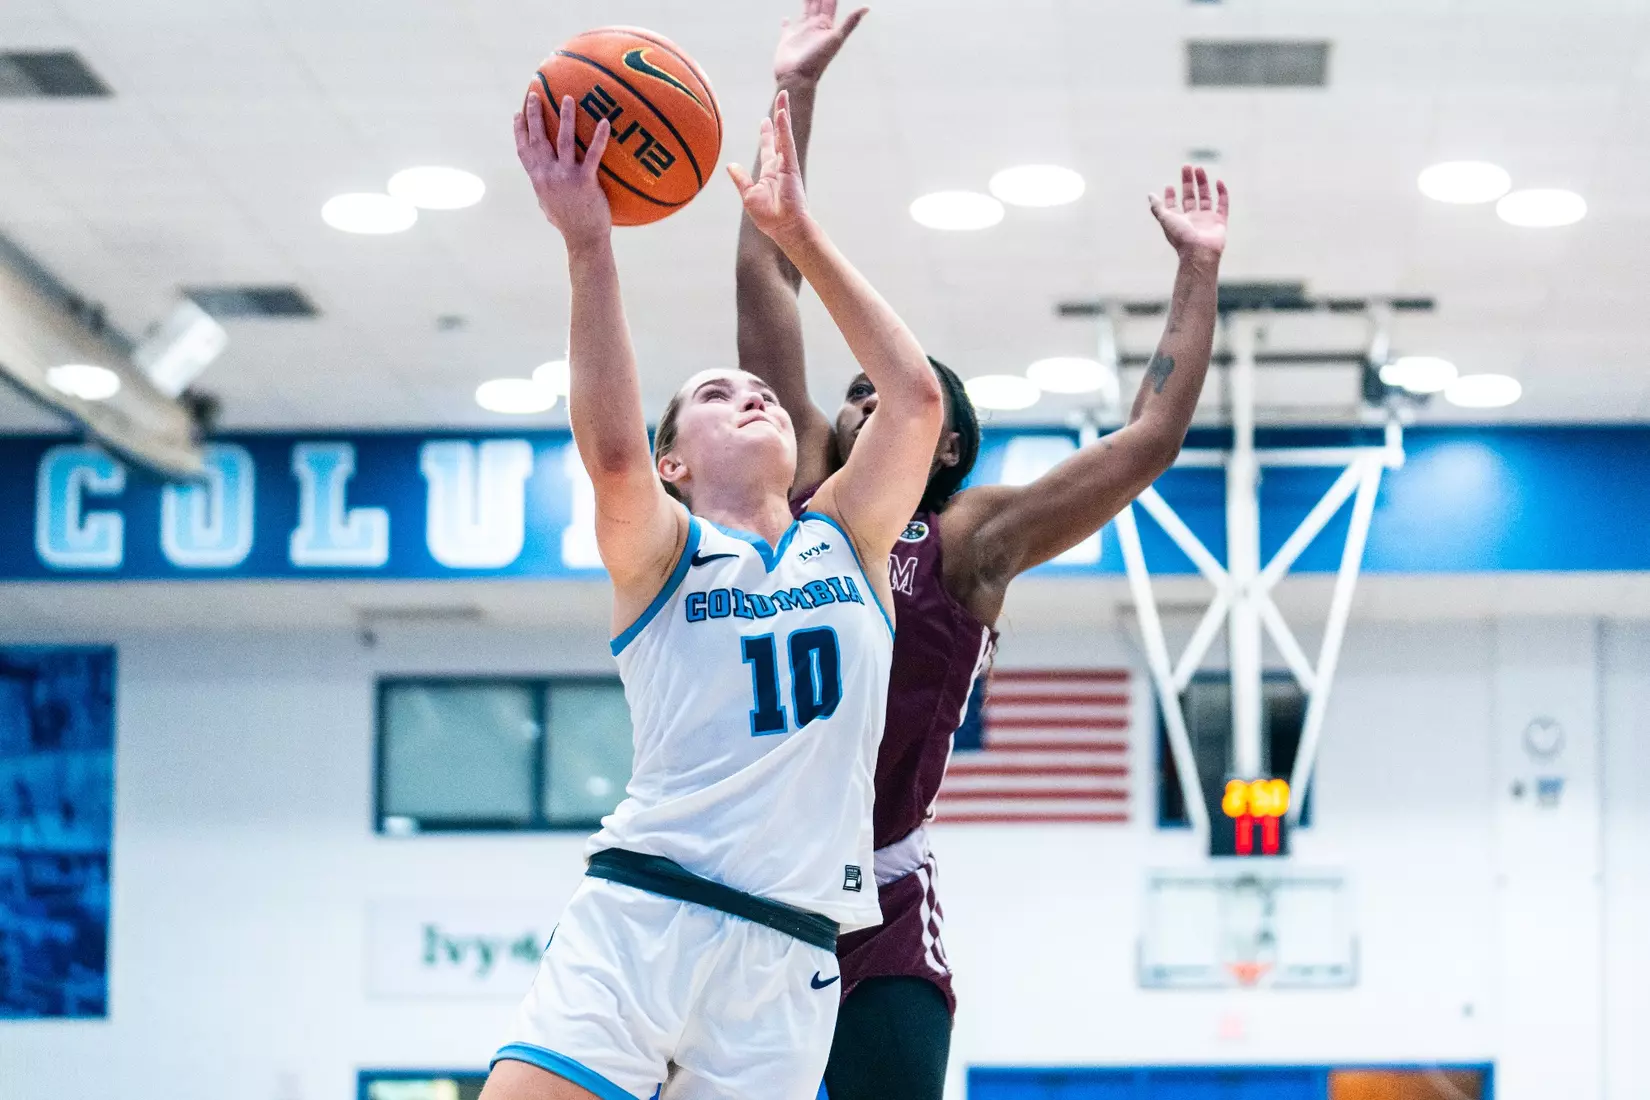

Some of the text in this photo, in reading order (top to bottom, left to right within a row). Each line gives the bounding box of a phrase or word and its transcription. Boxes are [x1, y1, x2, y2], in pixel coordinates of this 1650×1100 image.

[579, 84, 676, 178] ELITE
[799, 544, 821, 561] Ivy
[685, 575, 865, 623] COLUMBIA
[740, 625, 844, 737] 10
